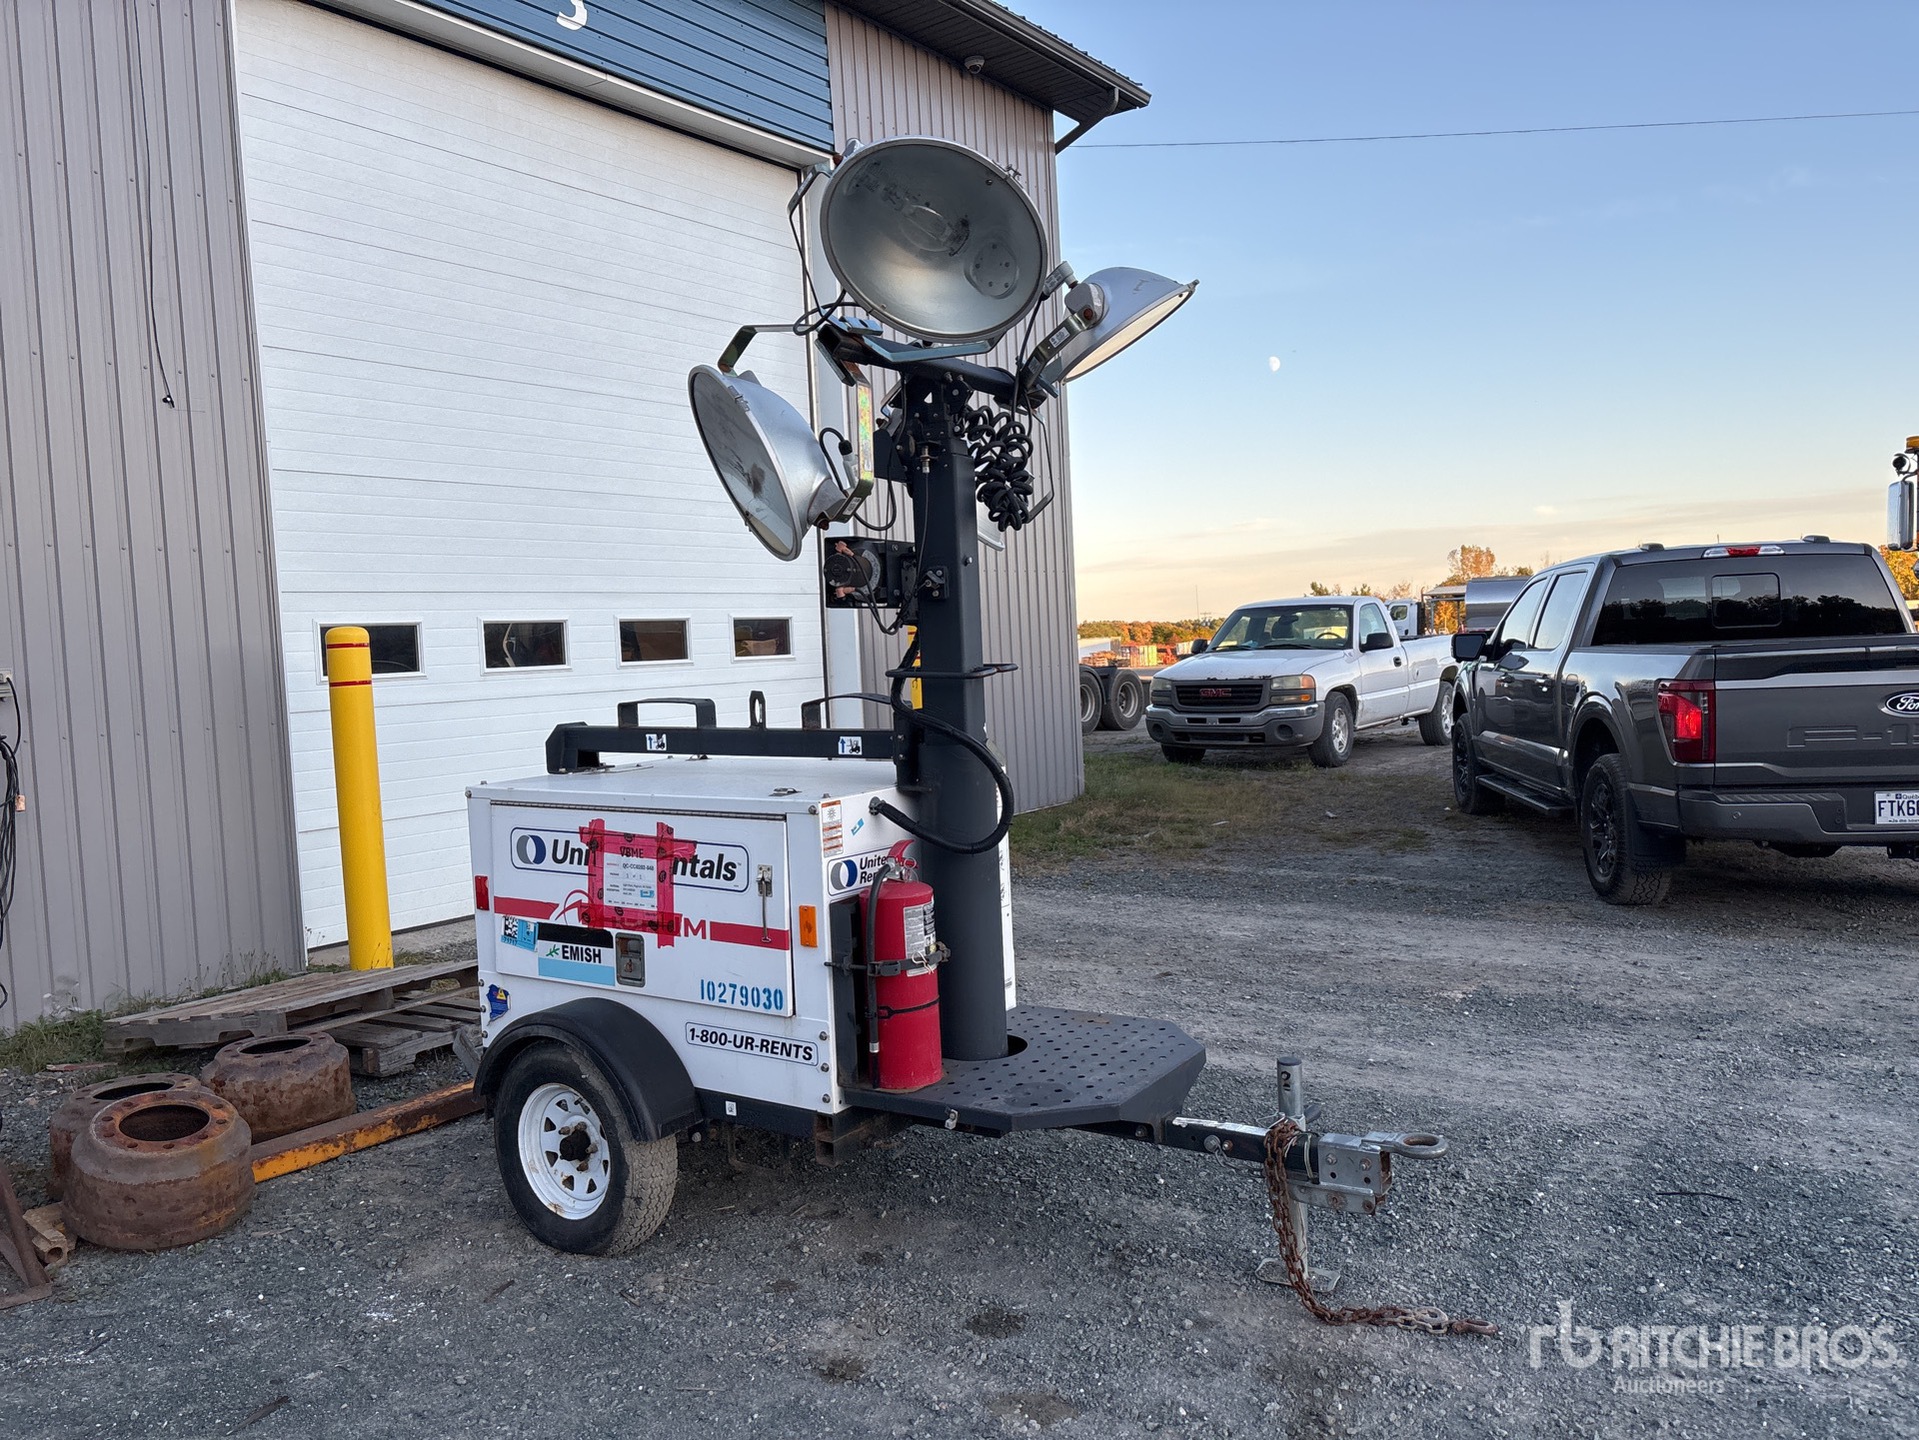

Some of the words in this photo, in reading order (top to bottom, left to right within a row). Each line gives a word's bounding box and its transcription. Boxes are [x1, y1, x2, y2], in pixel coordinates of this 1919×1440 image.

[1200, 688, 1231, 697] GMC
[1786, 723, 1919, 748] F-1
[551, 839, 592, 867] Uni
[672, 853, 738, 882] ntals
[619, 846, 644, 859] VBME
[860, 853, 888, 870] Unite
[561, 945, 602, 964] EMISH
[689, 1027, 813, 1061] 1-800-UR-RENTS
